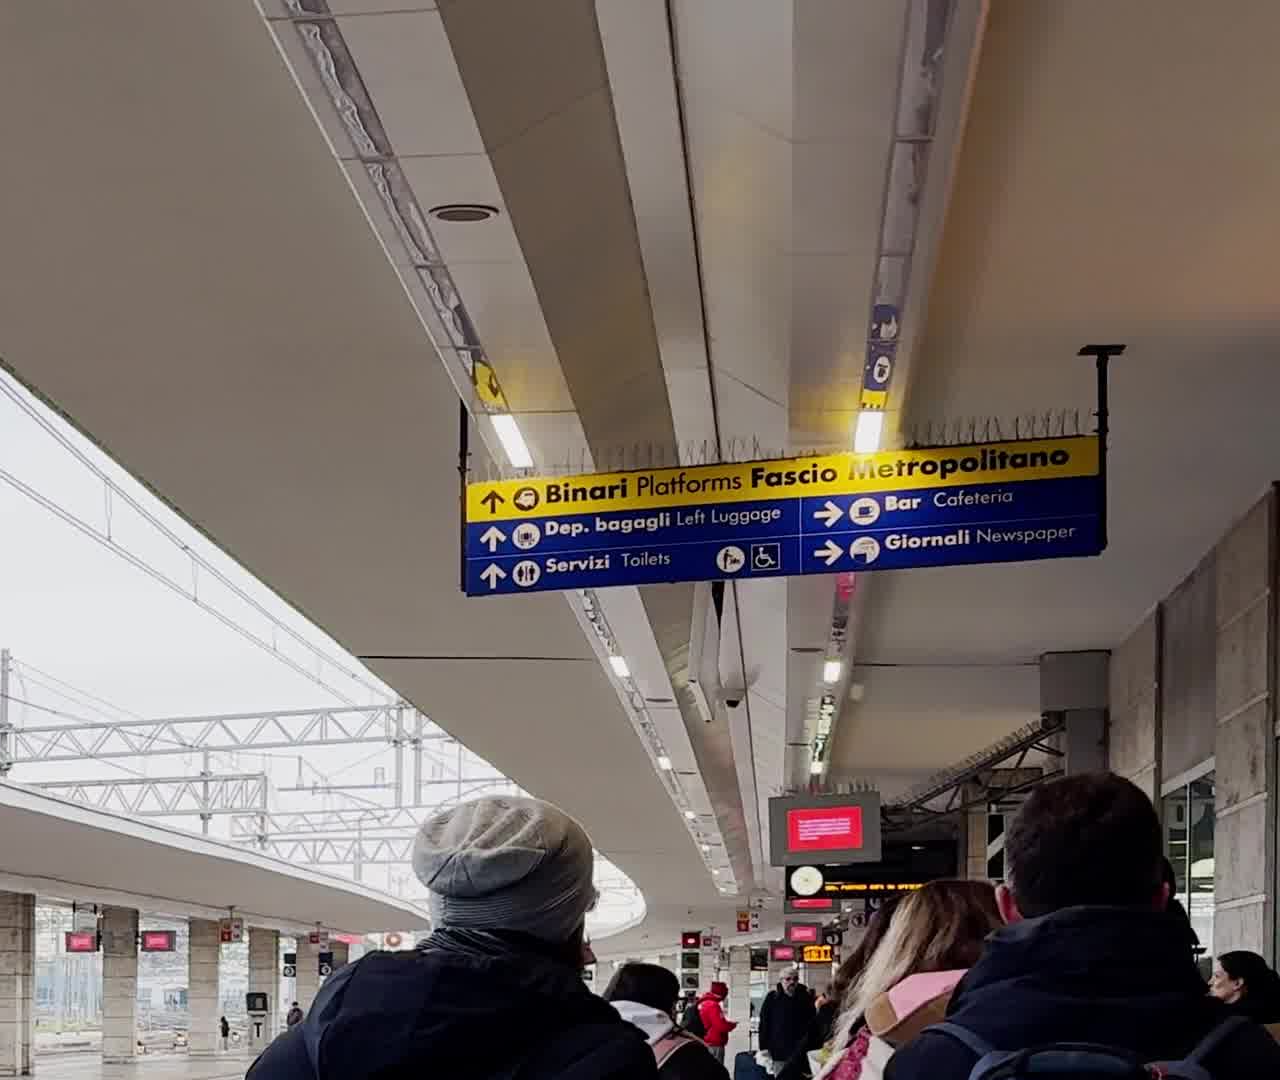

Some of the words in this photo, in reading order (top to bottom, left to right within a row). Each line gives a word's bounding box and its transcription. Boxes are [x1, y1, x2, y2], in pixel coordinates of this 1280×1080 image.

[546, 477, 628, 504] Binari
[637, 471, 742, 497] Platforms
[751, 463, 838, 489] Fascio
[847, 448, 1070, 480] Metropolitano
[885, 495, 922, 513] Bar
[933, 489, 1013, 508] Cafeteria
[545, 520, 590, 541] Dep.
[595, 513, 671, 535] bagagli
[677, 509, 705, 526] Left
[711, 506, 782, 527] Luggage
[885, 529, 971, 551] Giornali
[976, 525, 1077, 546] Newspaper
[545, 554, 610, 573] Servizi
[622, 551, 671, 567] Toilets
